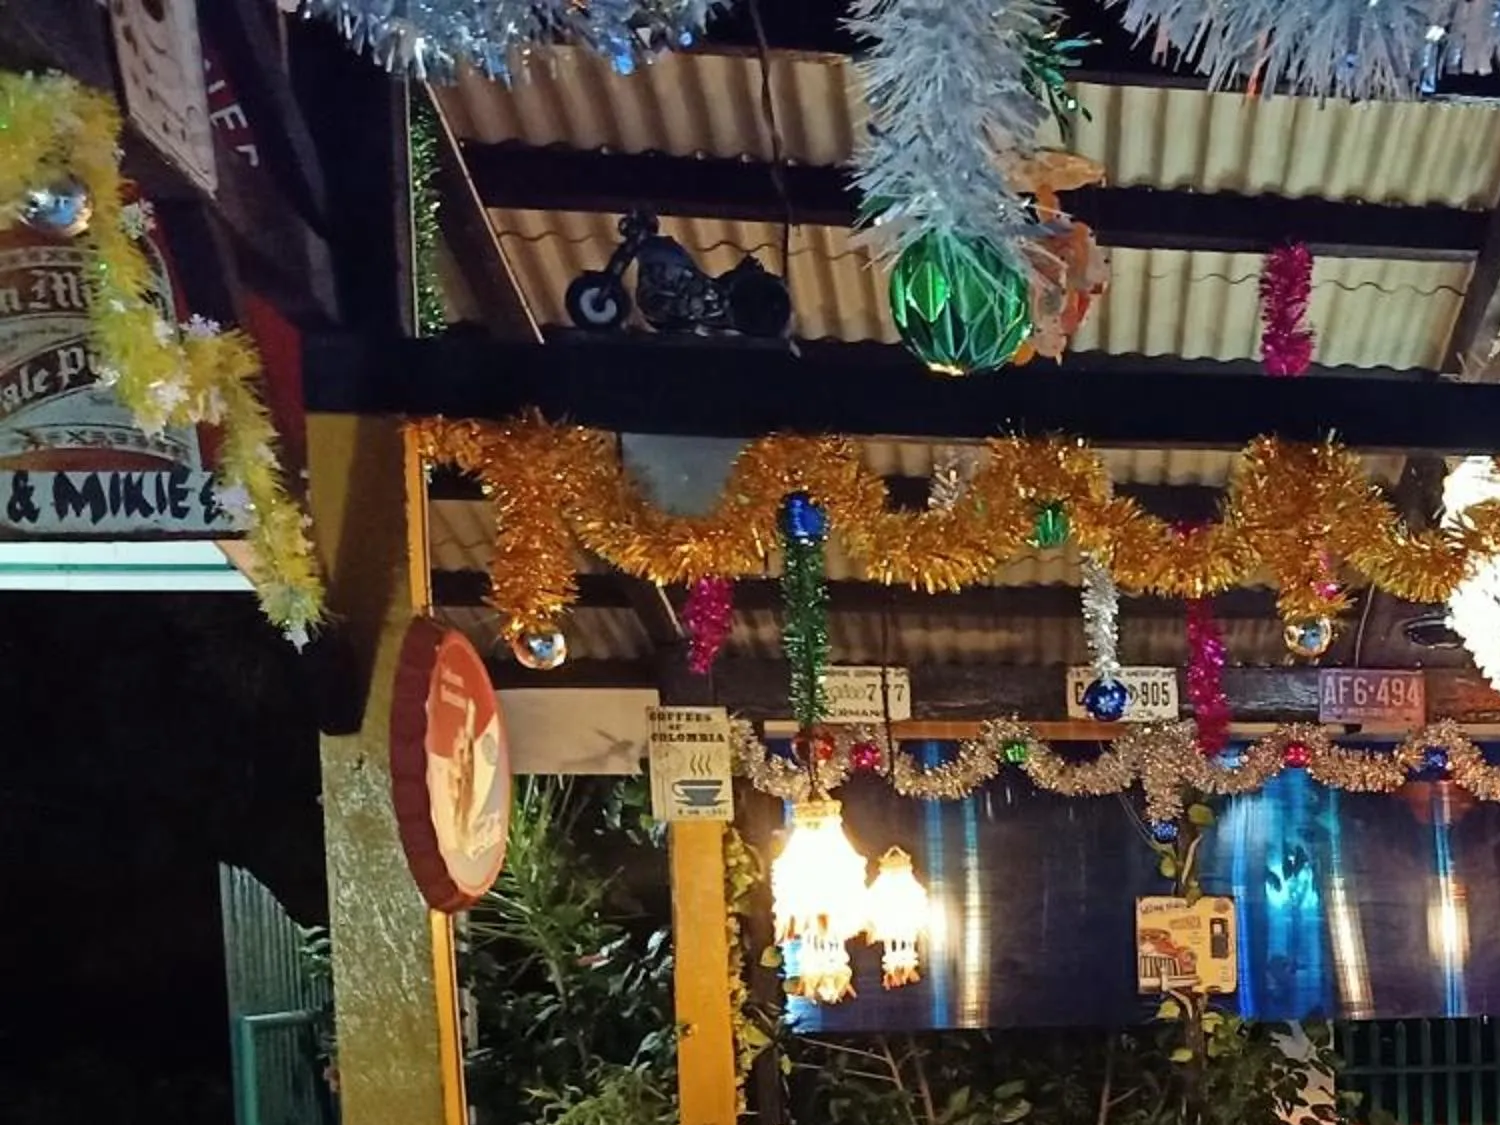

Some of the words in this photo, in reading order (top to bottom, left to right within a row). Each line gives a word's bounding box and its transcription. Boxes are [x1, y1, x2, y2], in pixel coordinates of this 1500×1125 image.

[7, 470, 41, 523] &
[1141, 682, 1170, 706] 905
[651, 733, 725, 742] COLOMBIA
